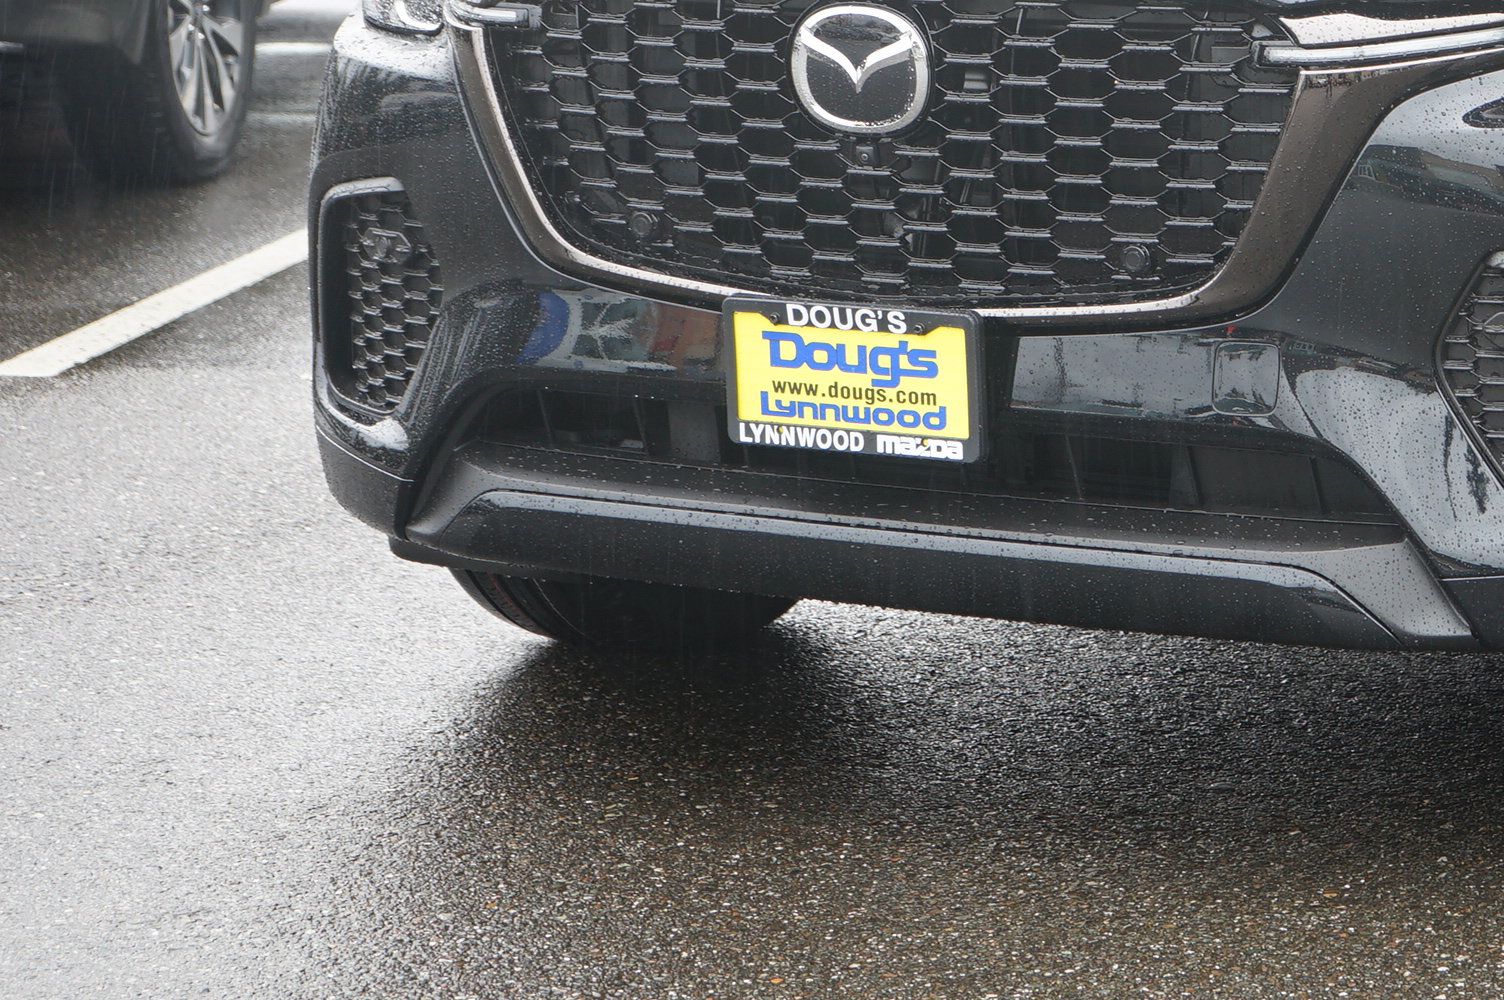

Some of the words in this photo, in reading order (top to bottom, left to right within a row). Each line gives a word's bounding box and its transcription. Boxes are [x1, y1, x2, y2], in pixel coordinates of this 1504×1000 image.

[785, 303, 908, 334] DOUG'S
[761, 331, 939, 388] Doug's
[771, 380, 937, 406] www.dougs.com
[760, 391, 947, 431] Lynnwood
[738, 423, 865, 452] LYNNWOOD
